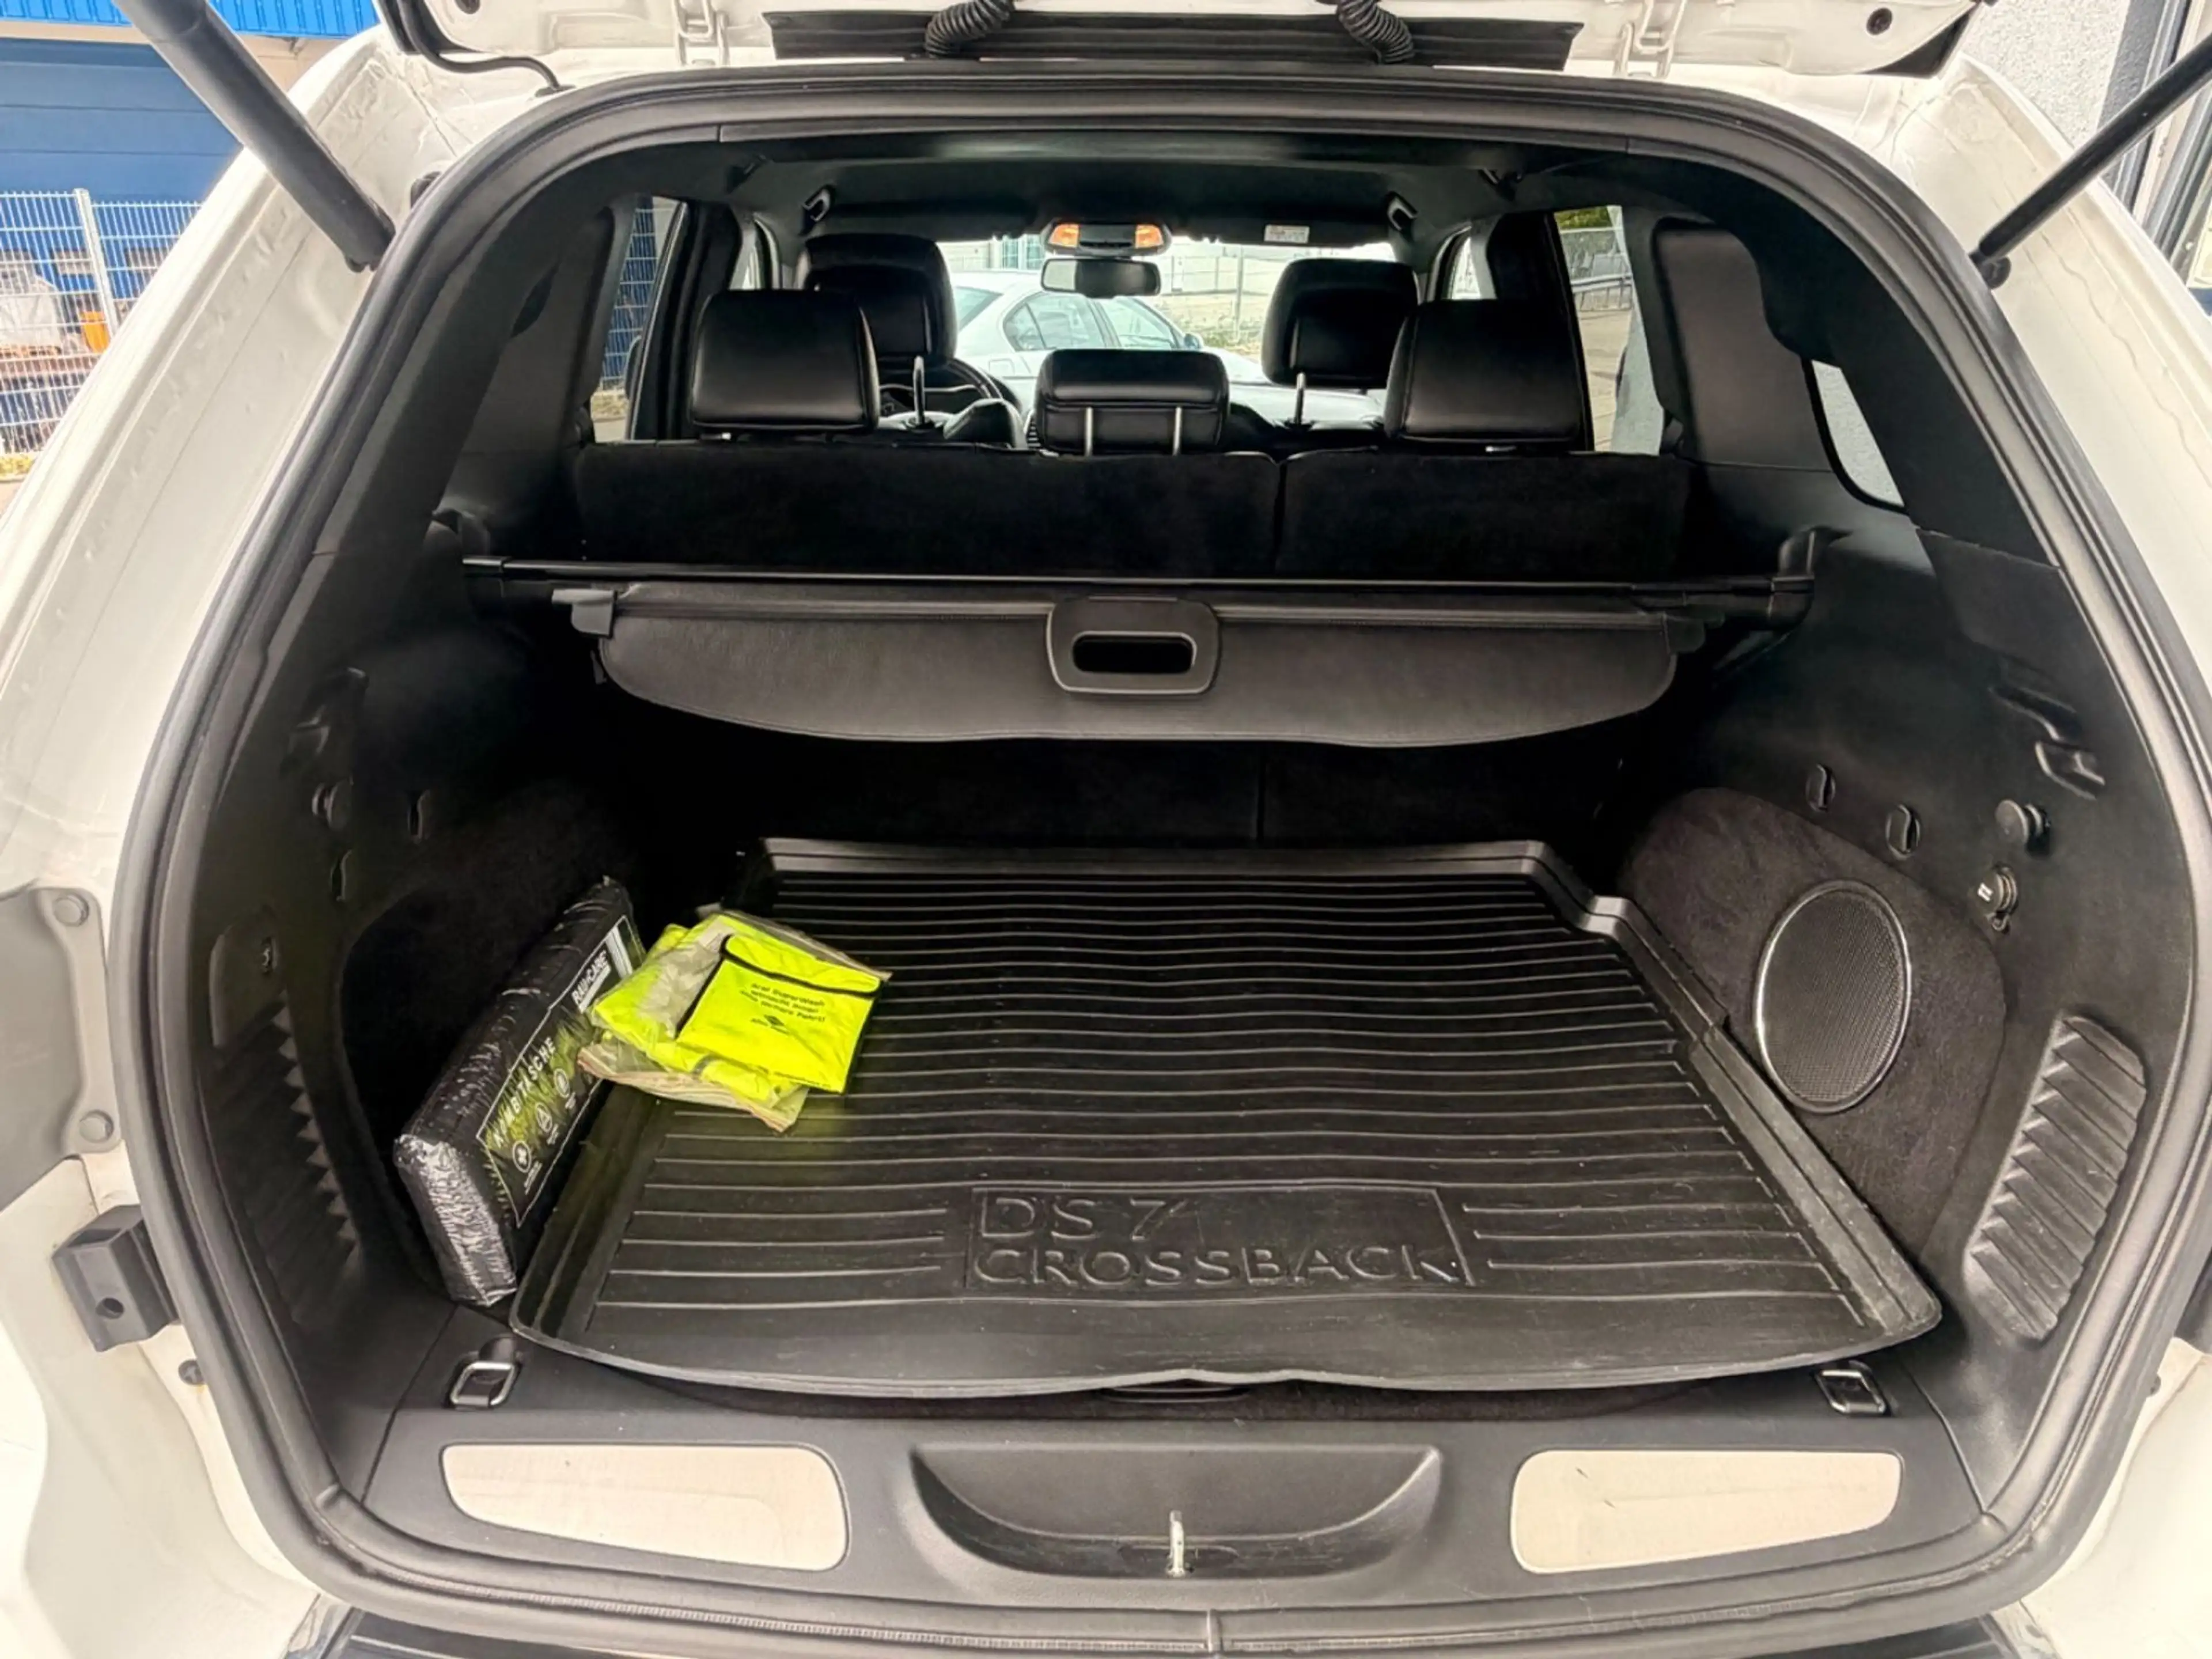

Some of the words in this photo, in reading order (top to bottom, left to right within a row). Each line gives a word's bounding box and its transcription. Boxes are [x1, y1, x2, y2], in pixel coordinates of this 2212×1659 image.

[981, 1196, 1099, 1240] DS
[1130, 1196, 1188, 1241] 7
[974, 1244, 1460, 1286] CROSSBACK
